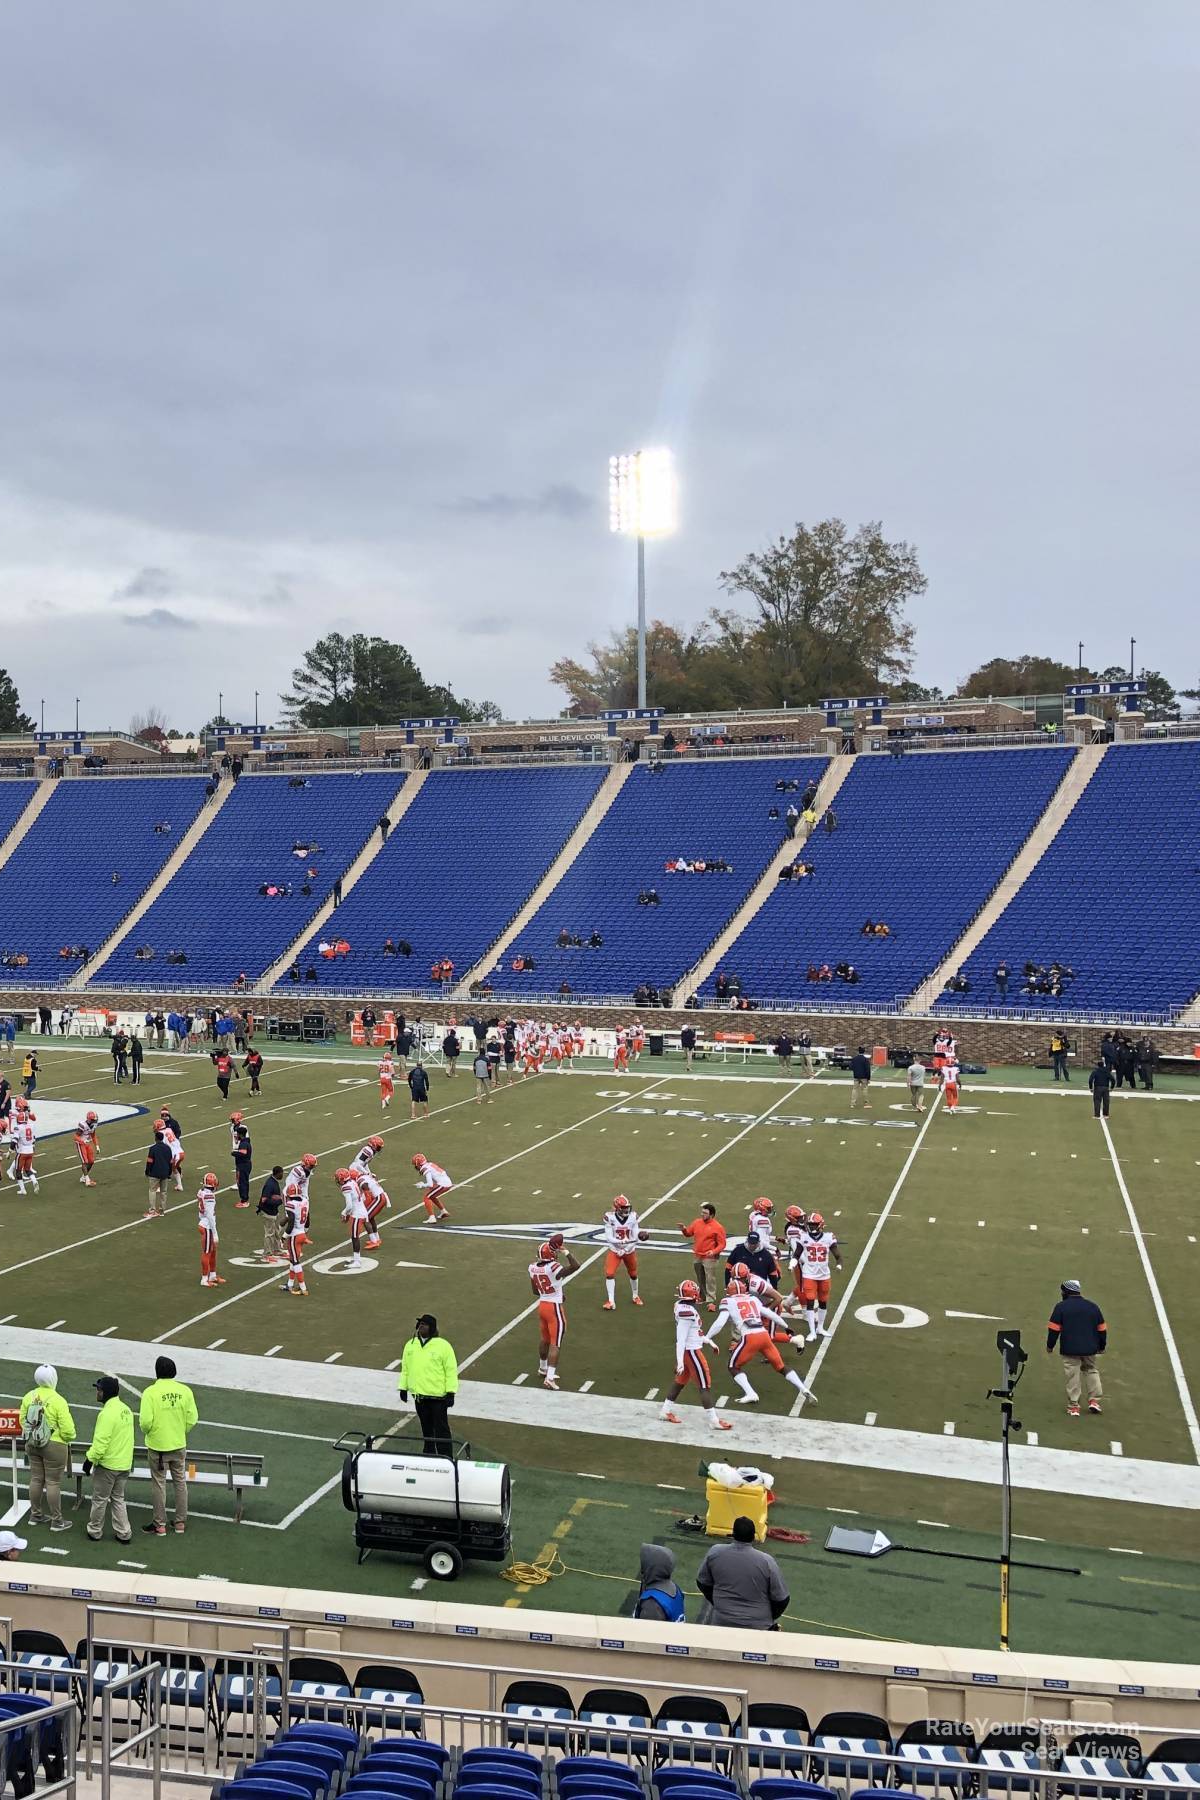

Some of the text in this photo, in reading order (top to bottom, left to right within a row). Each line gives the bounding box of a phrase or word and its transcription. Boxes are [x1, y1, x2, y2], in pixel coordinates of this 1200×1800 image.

[561, 734, 584, 742] DEVIL
[612, 1107, 919, 1127] BROOKS
[25, 1129, 33, 1141] 9
[807, 1246, 828, 1262] 33
[737, 1300, 761, 1319] 21
[161, 1392, 183, 1402] STAFF
